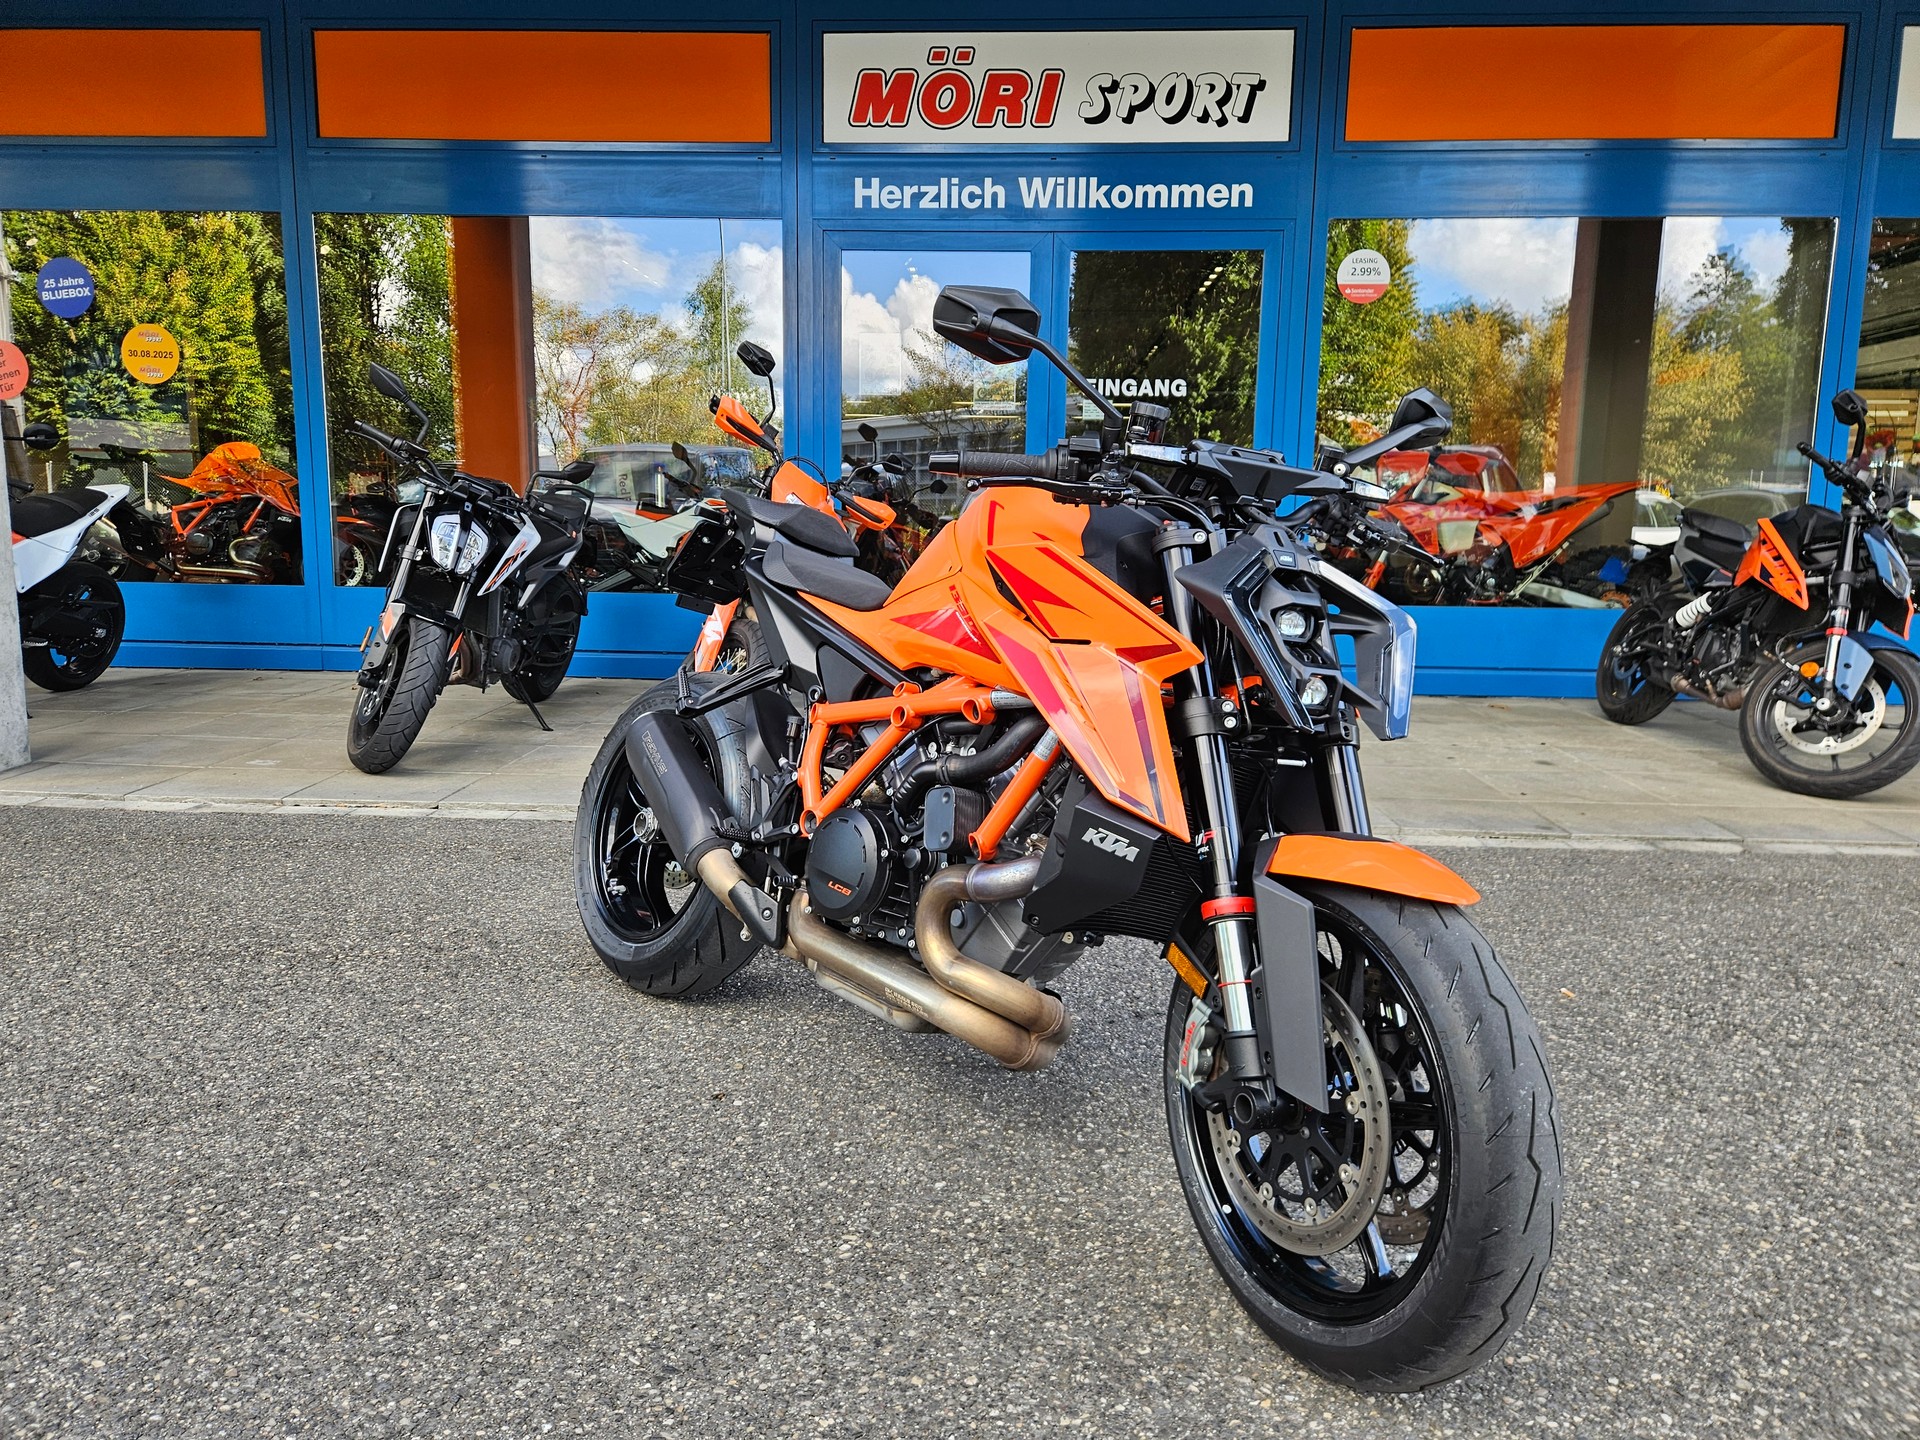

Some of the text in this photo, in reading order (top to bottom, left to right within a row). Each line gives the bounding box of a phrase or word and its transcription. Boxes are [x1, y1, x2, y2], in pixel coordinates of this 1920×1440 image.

[848, 46, 1267, 129] MÖRI SPORT
[854, 177, 1254, 210] Herzlich Willkommen
[1351, 257, 1379, 265] LEASING
[1350, 266, 1382, 276] 2.99%
[43, 276, 85, 289] 25 Jahre
[41, 286, 92, 301] BLUEBOX
[128, 349, 174, 359] 30.08.2025
[1081, 827, 1140, 862] KTM
